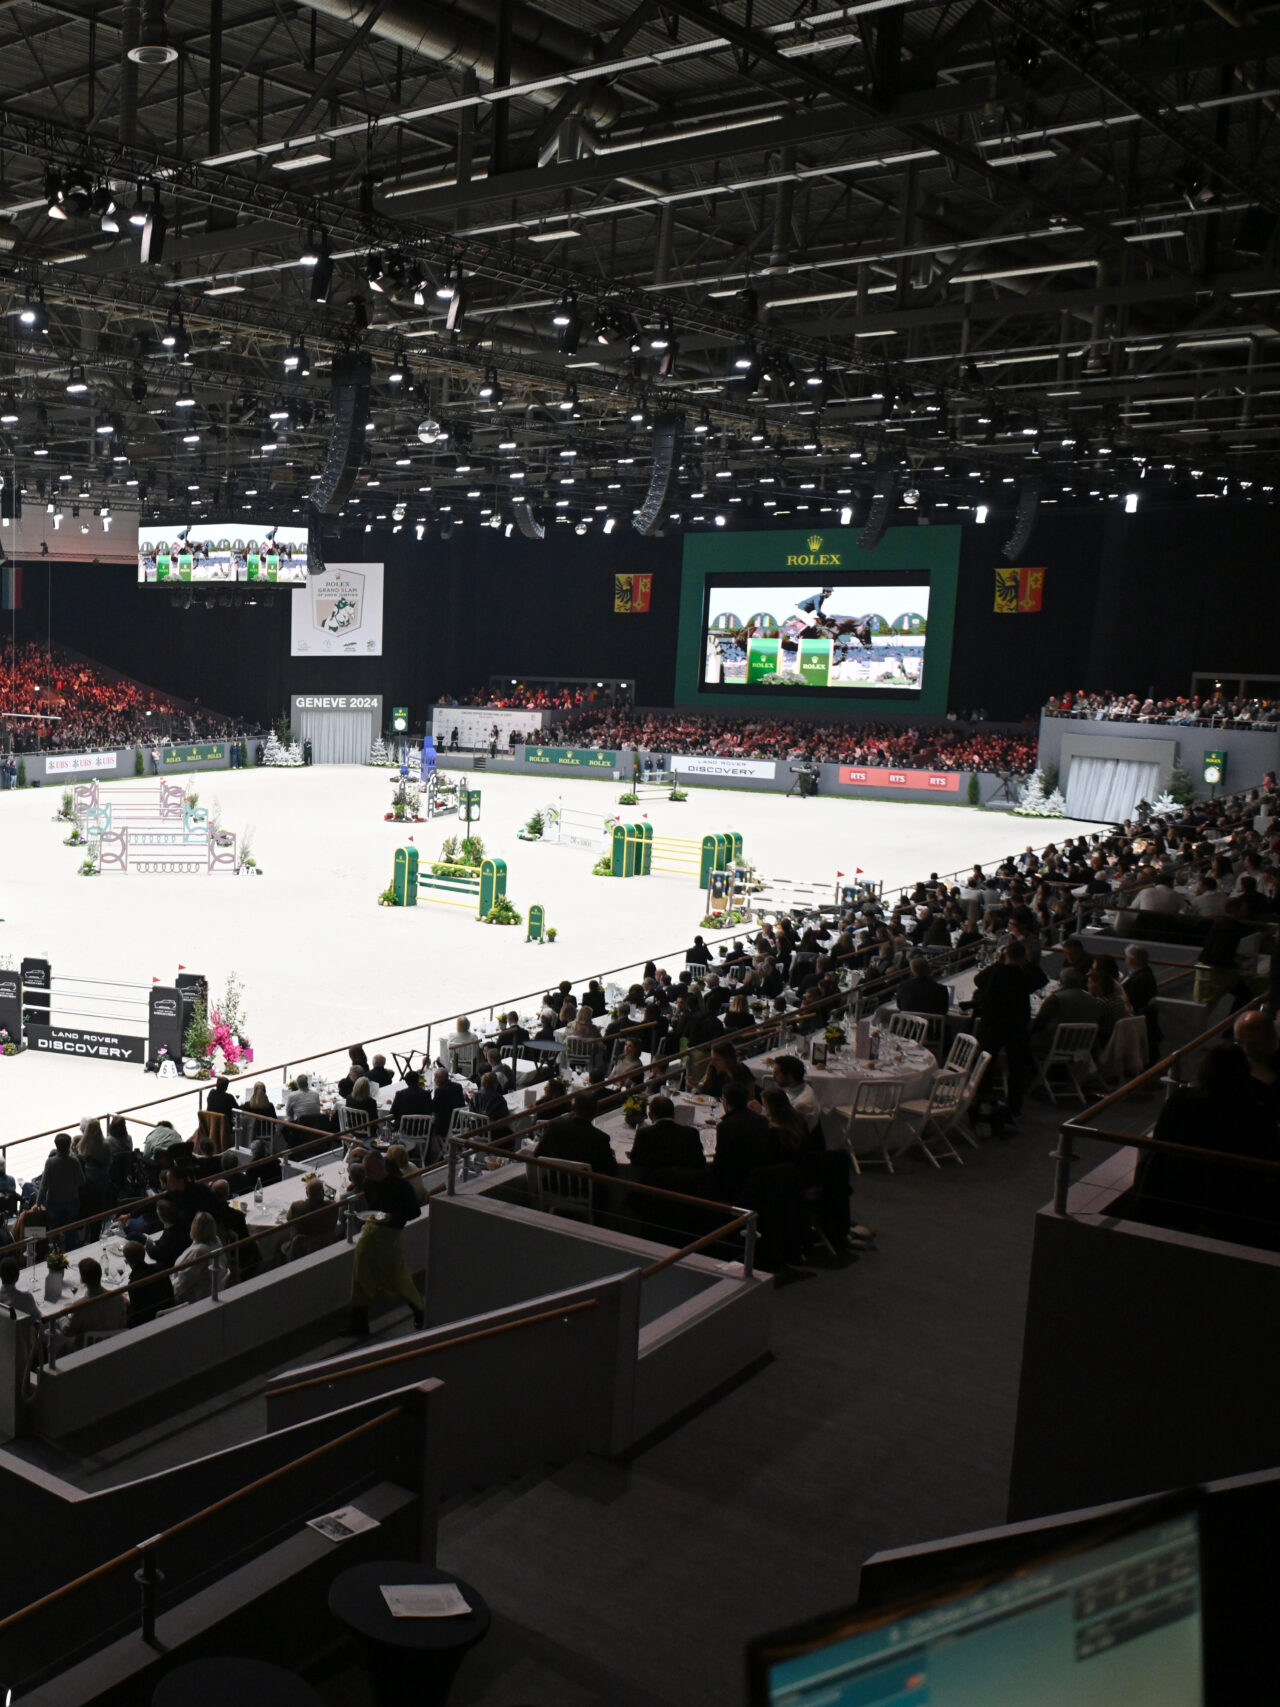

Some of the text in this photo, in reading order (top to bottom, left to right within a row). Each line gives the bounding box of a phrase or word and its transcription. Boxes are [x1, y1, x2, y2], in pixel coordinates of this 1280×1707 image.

[787, 554, 840, 566] ROLEX
[296, 698, 378, 708] GENEVE 2024
[56, 761, 69, 769] UBS
[688, 766, 755, 775] DISCOVERY
[850, 772, 866, 780] RTS
[52, 1031, 119, 1044] LAND ROVER
[38, 1039, 132, 1058] DISCOVERY
